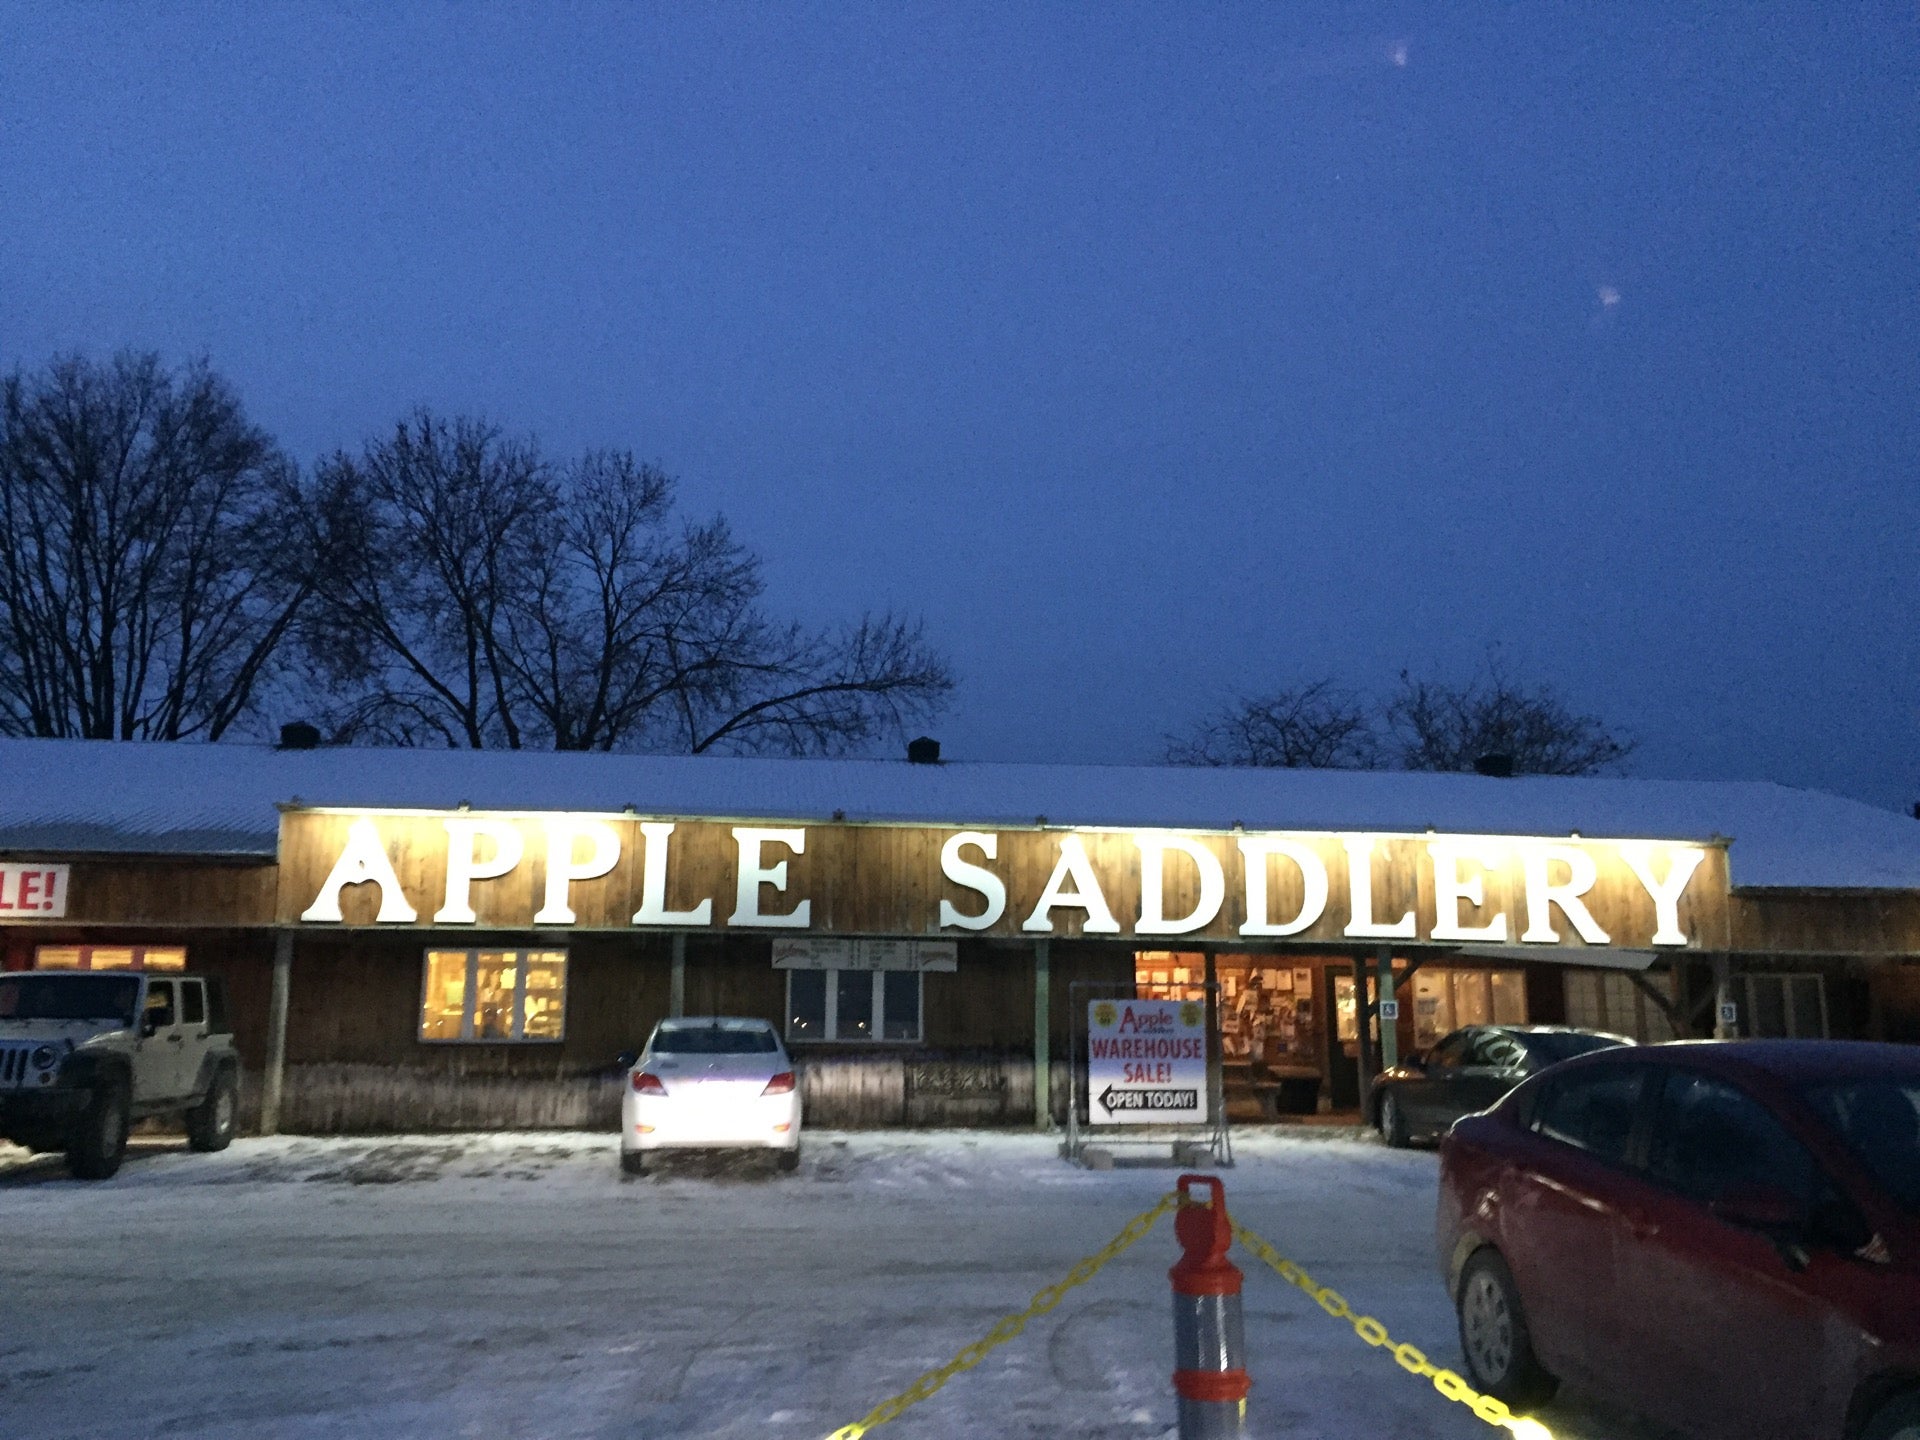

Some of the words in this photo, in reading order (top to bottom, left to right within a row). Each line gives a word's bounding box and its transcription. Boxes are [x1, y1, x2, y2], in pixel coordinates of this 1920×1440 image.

[300, 815, 811, 928] APPLE
[939, 829, 1706, 947] SADDLERY
[1118, 1006, 1173, 1034] Apple
[1091, 1038, 1202, 1060] WAREHOUSE
[1123, 1062, 1172, 1083] SALE!
[1106, 1091, 1144, 1108] OPEN
[1145, 1090, 1195, 1108] TODAY!
